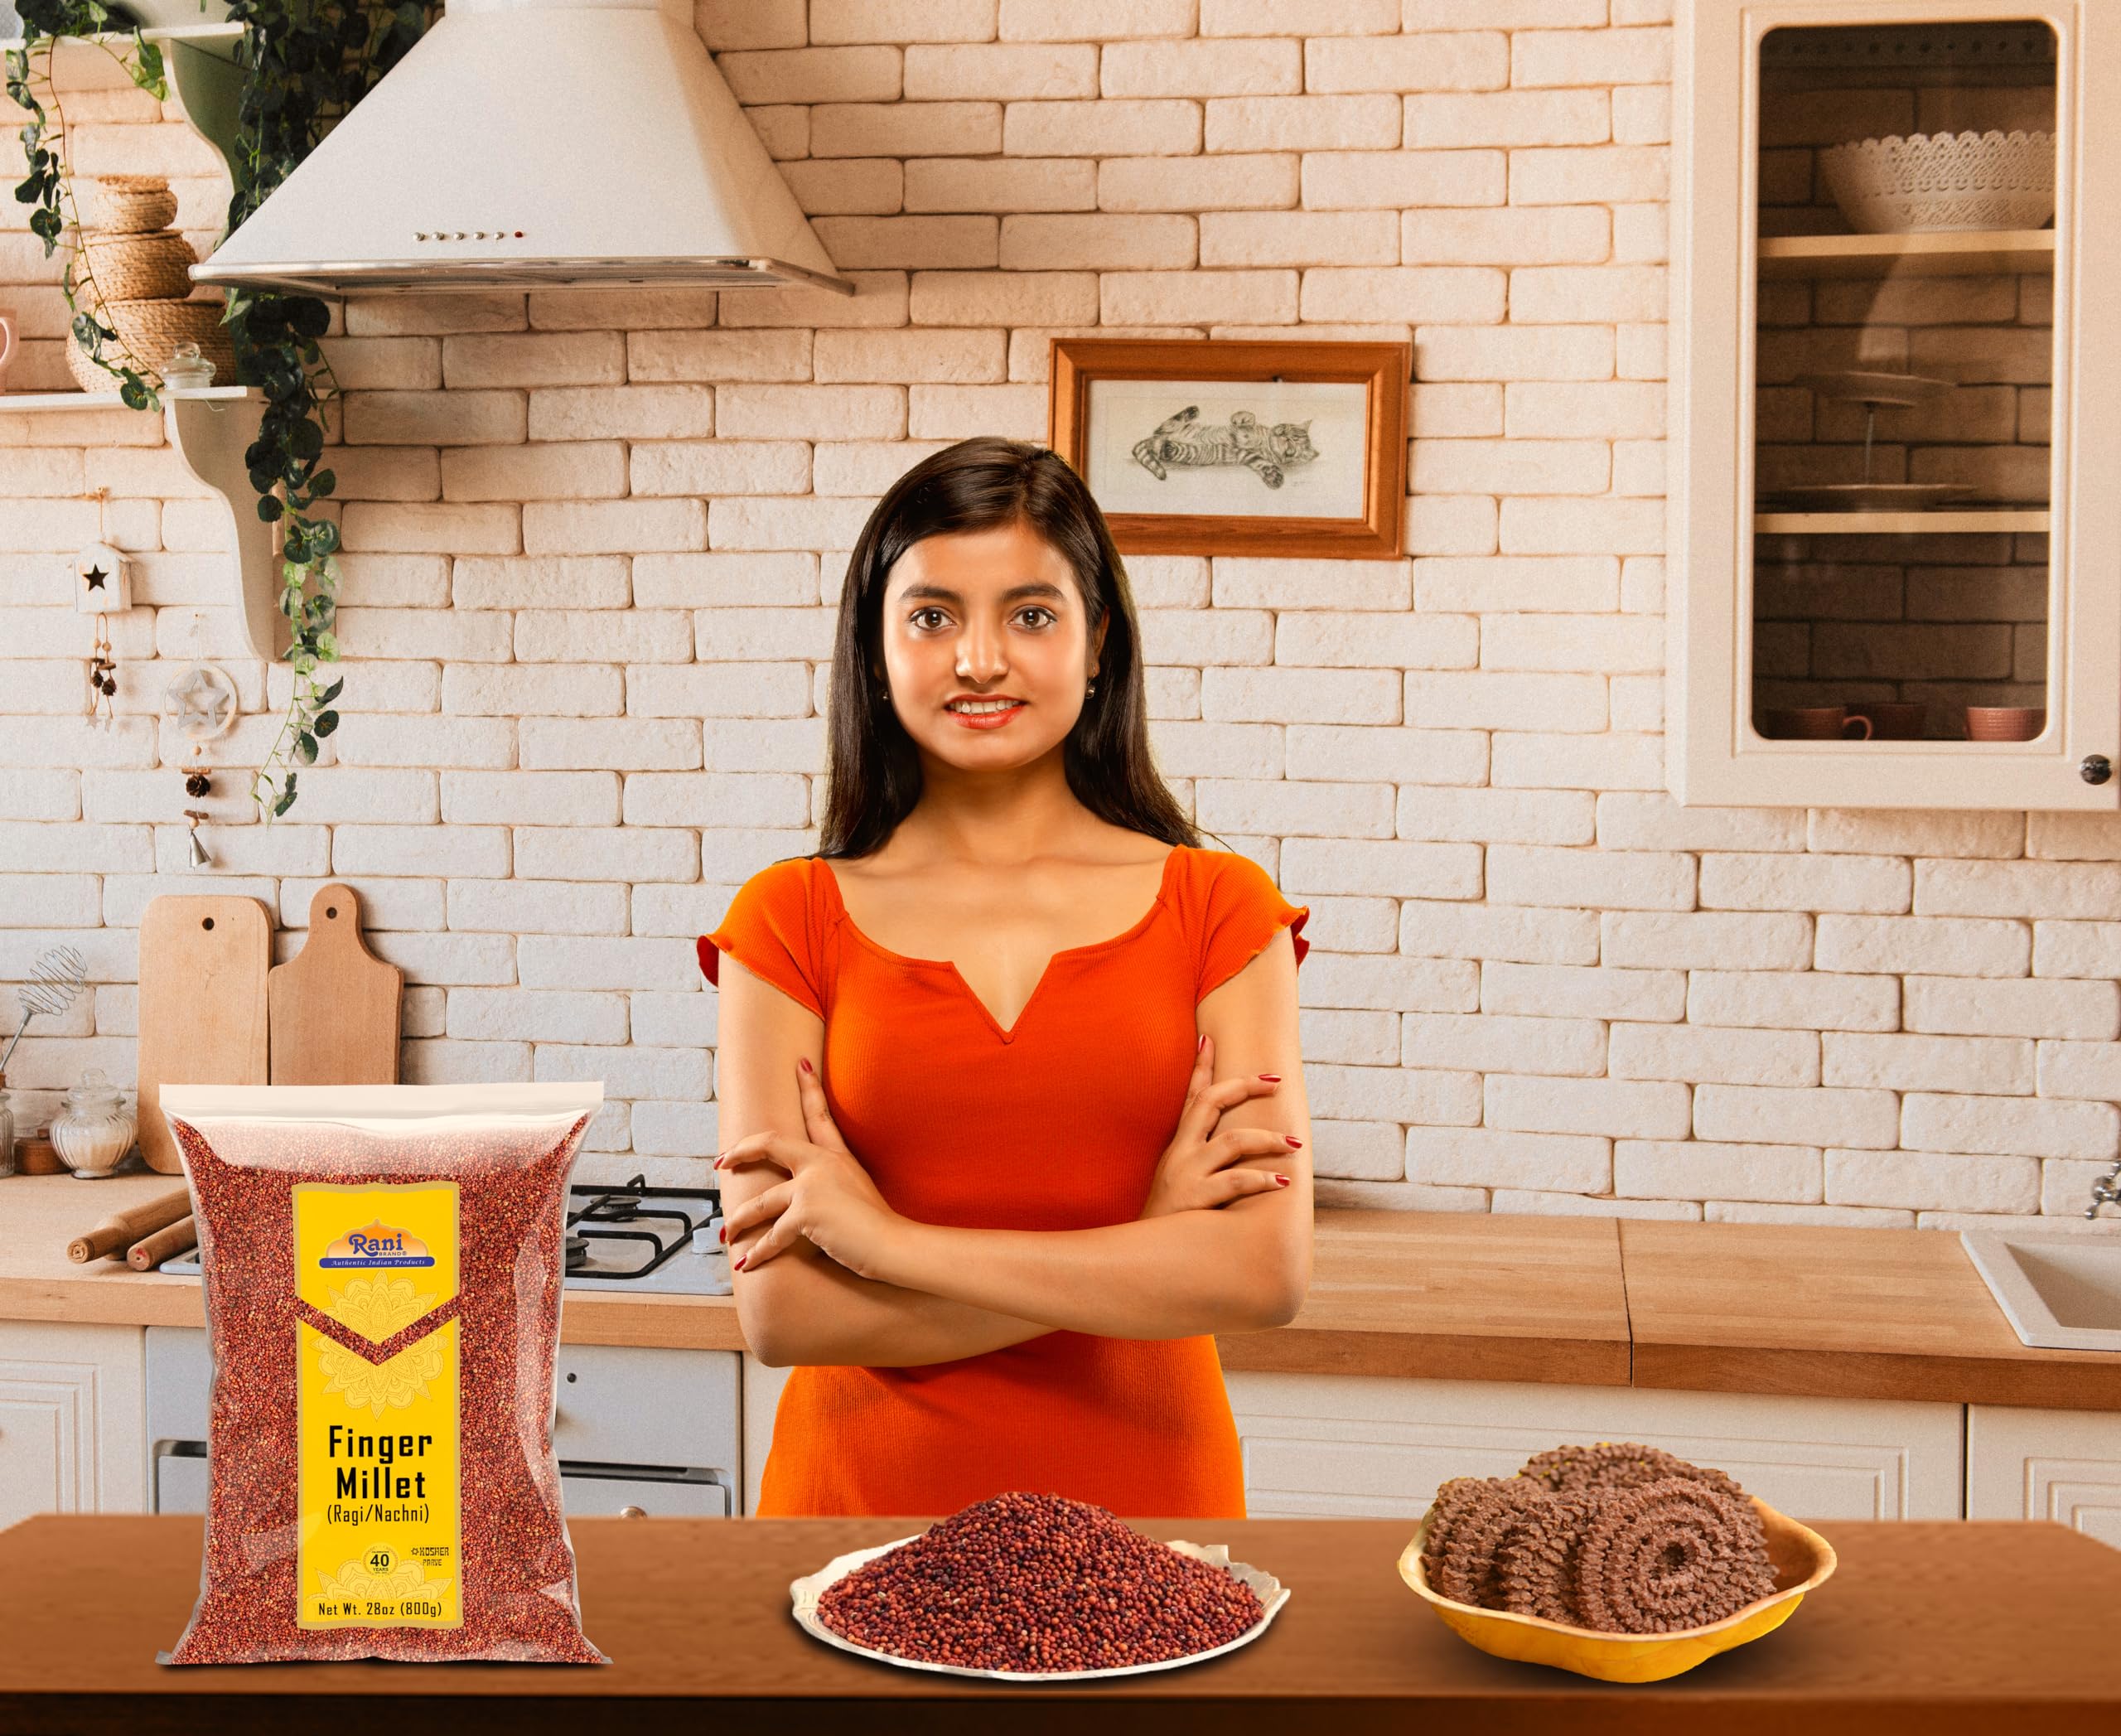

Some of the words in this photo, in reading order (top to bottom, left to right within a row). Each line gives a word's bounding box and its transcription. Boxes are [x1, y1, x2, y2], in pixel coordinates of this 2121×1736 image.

[348, 1233, 403, 1257] Rani
[329, 1425, 432, 1464] Finger
[336, 1467, 426, 1499] Millet
[327, 1503, 429, 1526] (Ragi/Nachni)
[370, 1554, 389, 1567] 40
[419, 1547, 449, 1556] KOSHER
[318, 1603, 338, 1615] Net
[343, 1603, 361, 1615] Wt.
[366, 1603, 395, 1615] 28oz
[400, 1602, 442, 1617] (800g)
